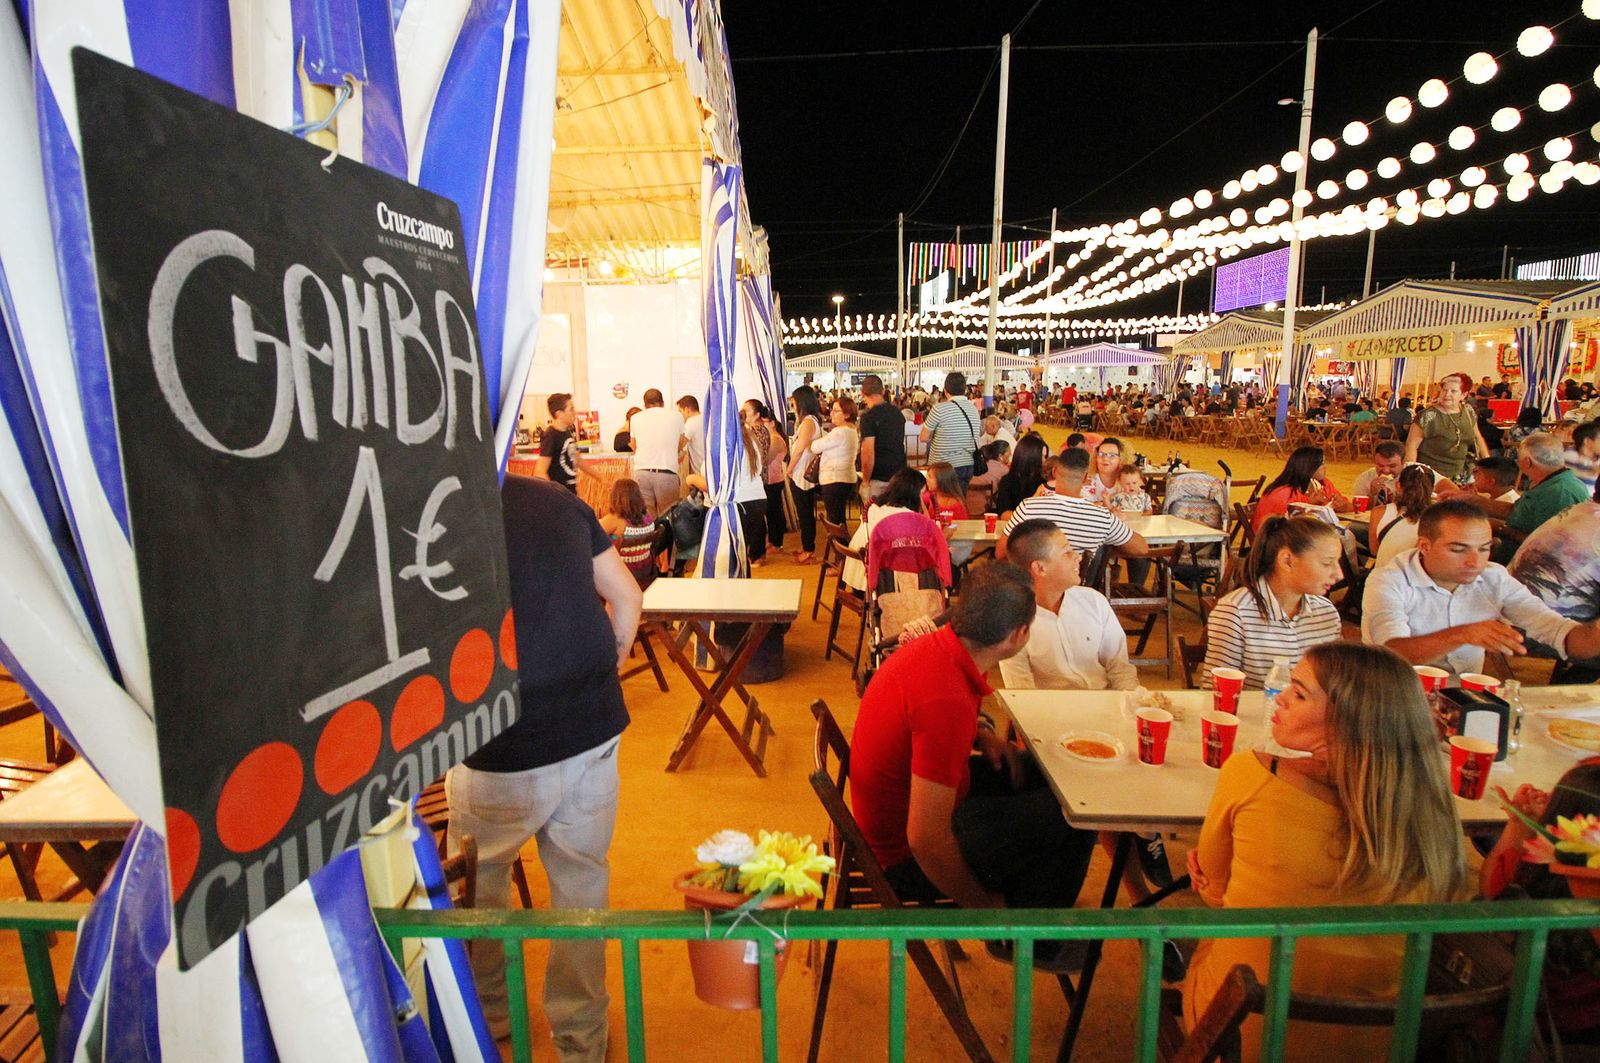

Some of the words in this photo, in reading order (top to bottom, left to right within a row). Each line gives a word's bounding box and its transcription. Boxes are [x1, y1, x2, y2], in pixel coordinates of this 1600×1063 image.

[376, 201, 454, 250] Cruzcampo
[378, 235, 418, 253] MAESTROS
[148, 229, 483, 458] GAMBA
[1356, 338, 1373, 356] LA
[1377, 334, 1443, 355] MERCED
